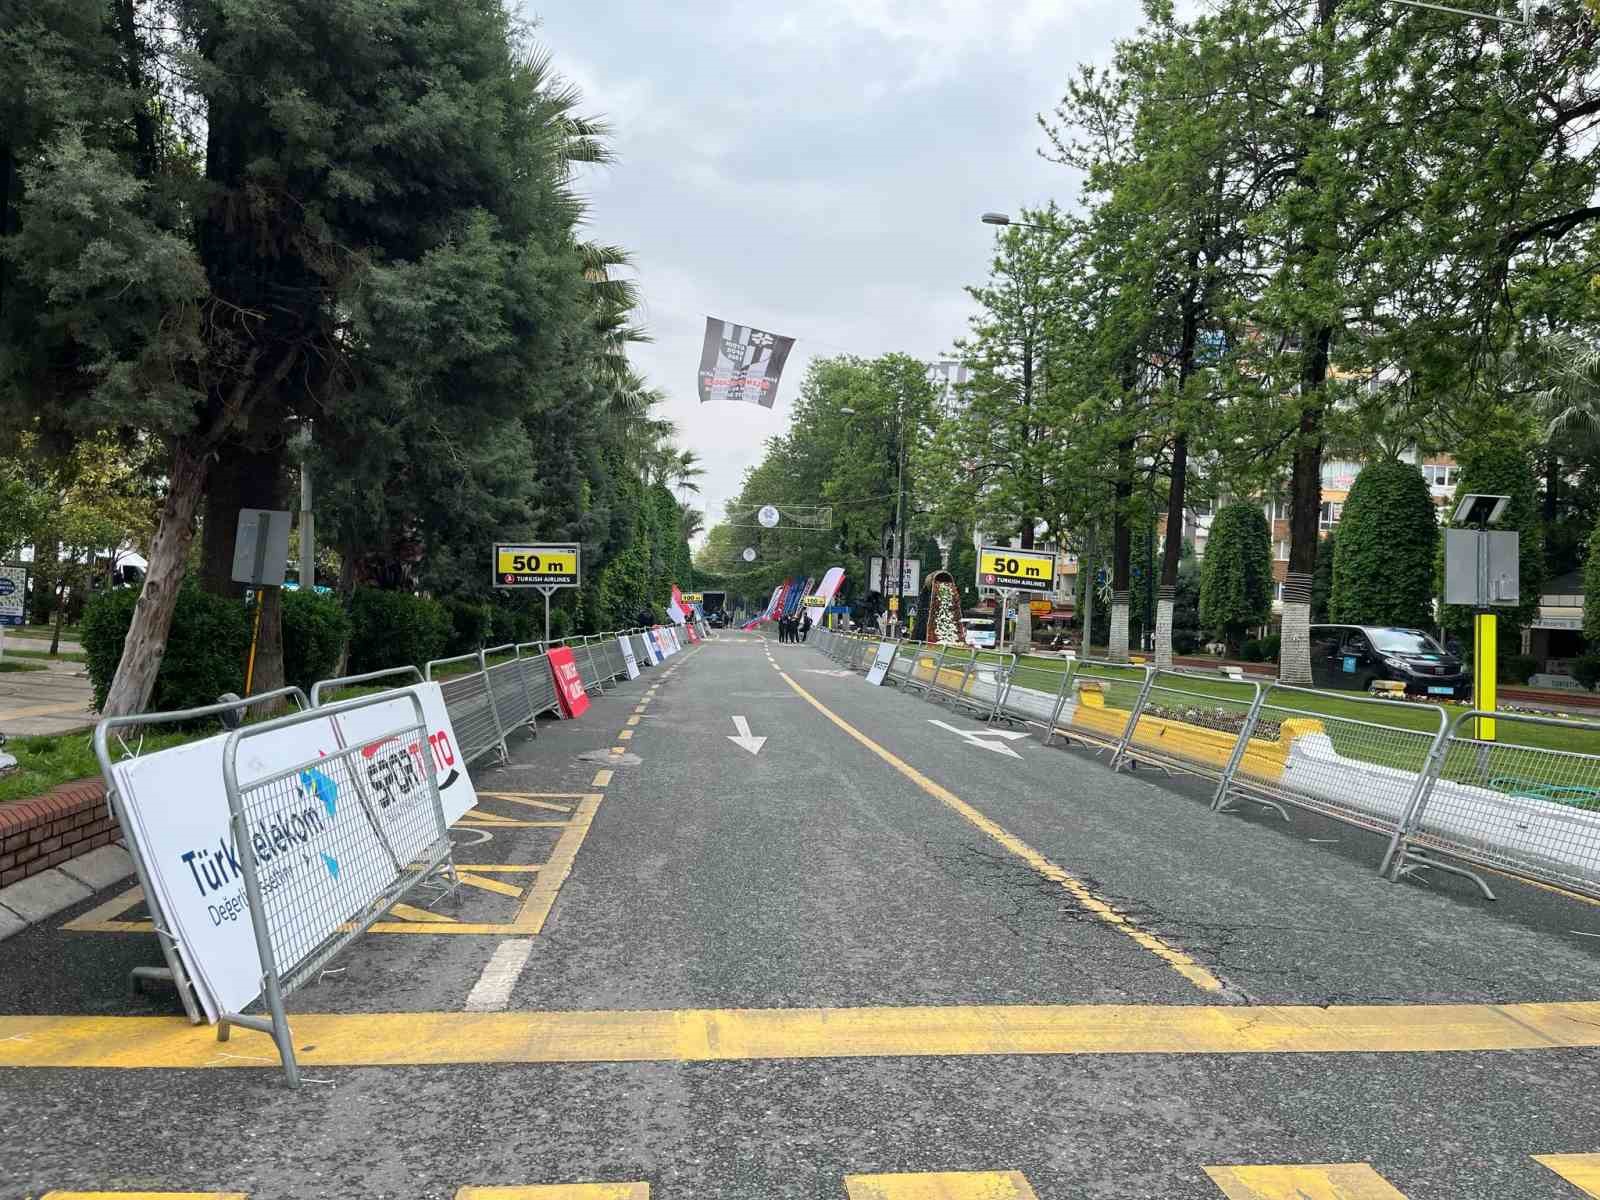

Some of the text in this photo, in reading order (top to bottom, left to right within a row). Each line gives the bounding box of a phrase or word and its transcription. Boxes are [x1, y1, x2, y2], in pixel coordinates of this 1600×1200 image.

[512, 556, 564, 572] 50 m
[993, 557, 1040, 576] 50 m
[181, 837, 245, 897] Türk
[253, 806, 325, 867] elekom
